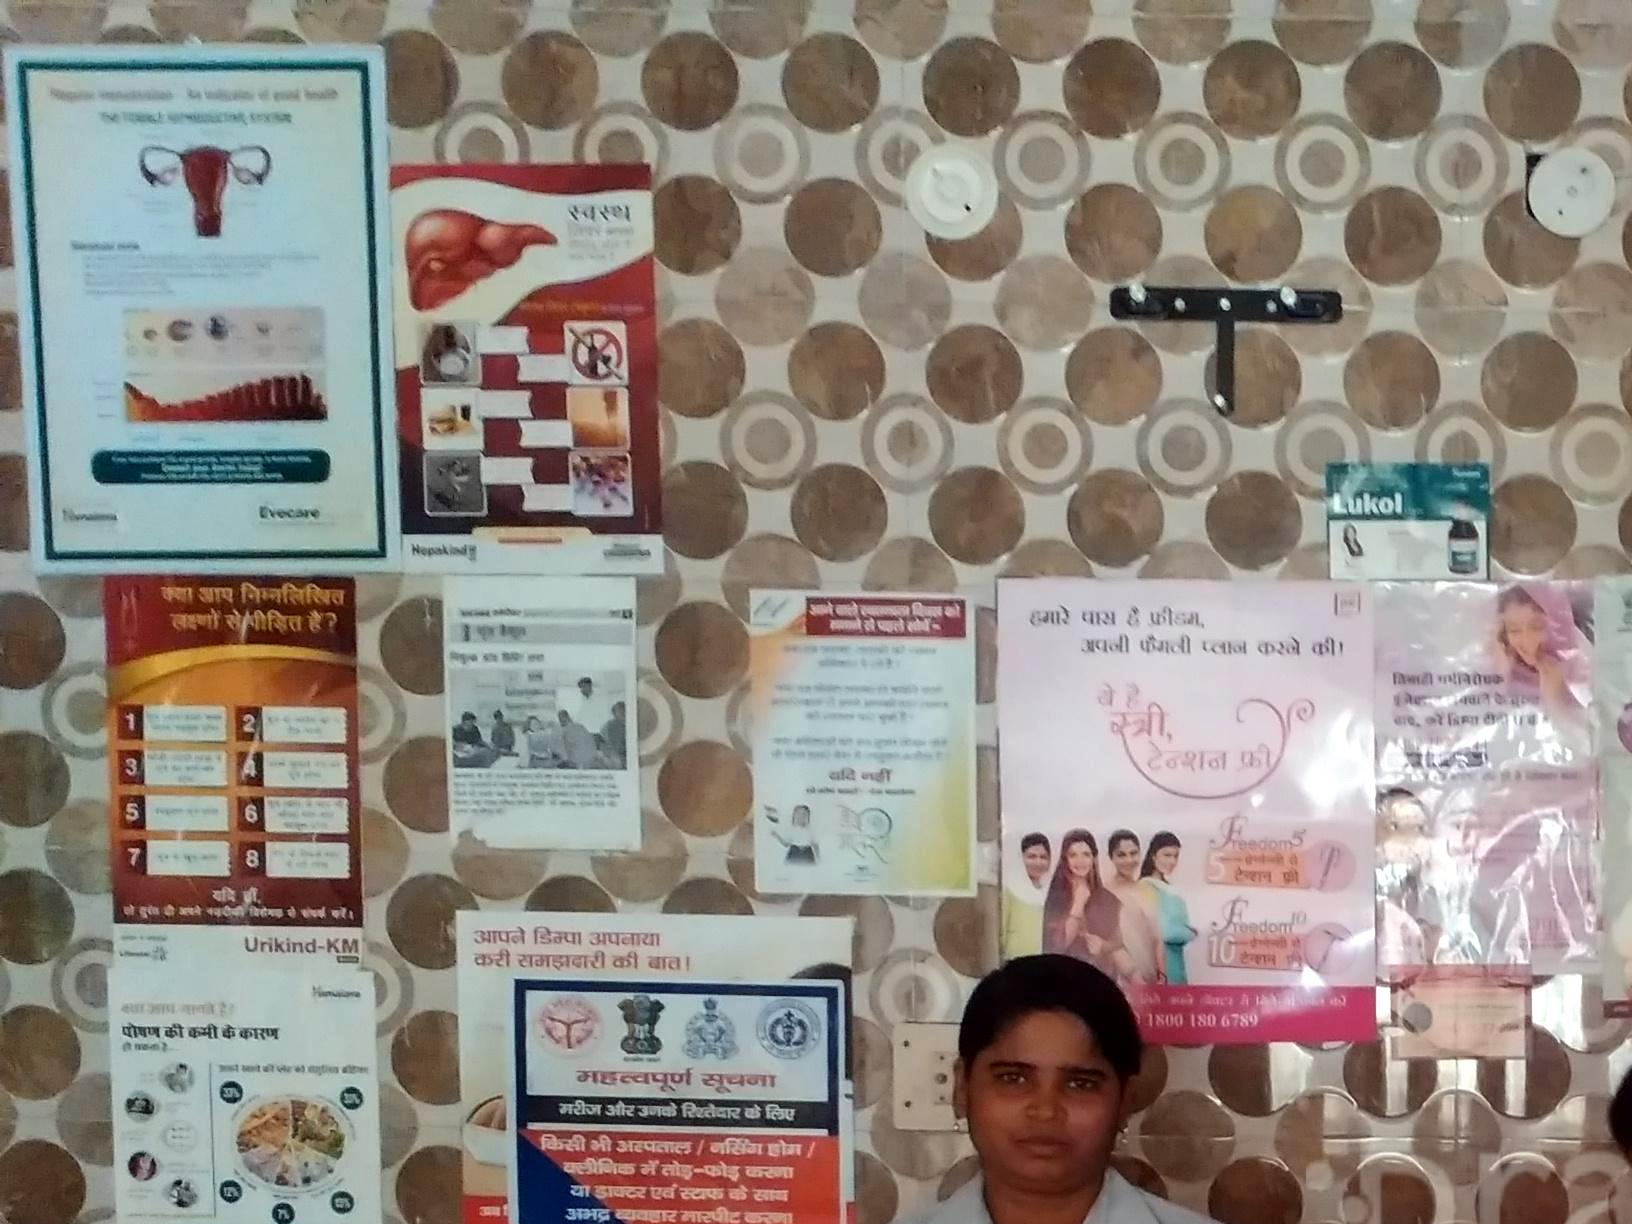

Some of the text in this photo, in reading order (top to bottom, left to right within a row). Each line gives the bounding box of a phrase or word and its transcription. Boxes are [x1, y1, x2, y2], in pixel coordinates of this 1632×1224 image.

[1333, 493, 1403, 515] Lukol
[161, 582, 345, 606] क्या आप निम्नलिखित
[1029, 607, 1071, 627] हमारे
[1081, 610, 1116, 627] पास
[1081, 634, 1130, 655] अपनी
[1202, 640, 1248, 656] प्लान
[1257, 635, 1301, 657] करने
[125, 714, 136, 732] 1
[242, 714, 256, 734] 2
[125, 758, 138, 777] 3
[125, 803, 140, 822] 5
[244, 803, 258, 824] 6
[127, 847, 141, 867] 7
[245, 849, 259, 869] 8
[244, 936, 360, 955] Urikind-KM
[474, 926, 661, 946] आपने डिम्पा अपनाया
[1208, 934, 1235, 964] 10
[474, 949, 511, 968] करी
[517, 950, 606, 972] समझदारी
[613, 950, 639, 970] की
[1149, 1013, 1259, 1028] 1800 180 6789
[121, 1023, 280, 1041] पोषण की कमी के कारण
[576, 1067, 778, 1095] महत्वपूर्ण सूचना
[559, 1101, 602, 1117] मरीज
[605, 1101, 635, 1117] और
[637, 1101, 677, 1118] उनके
[744, 1103, 762, 1120] के
[765, 1103, 796, 1121] लिए
[540, 1134, 586, 1152] किसी
[589, 1135, 612, 1152] भी
[616, 1139, 692, 1156] अस्पताल
[766, 1139, 801, 1158] होम
[641, 1157, 660, 1177] में
[745, 1165, 795, 1180] करना
[570, 1184, 591, 1199] या
[650, 1182, 677, 1200] एवं
[728, 1184, 749, 1201] के
[752, 1188, 789, 1203] साथ
[565, 1206, 611, 1223] अभद्र
